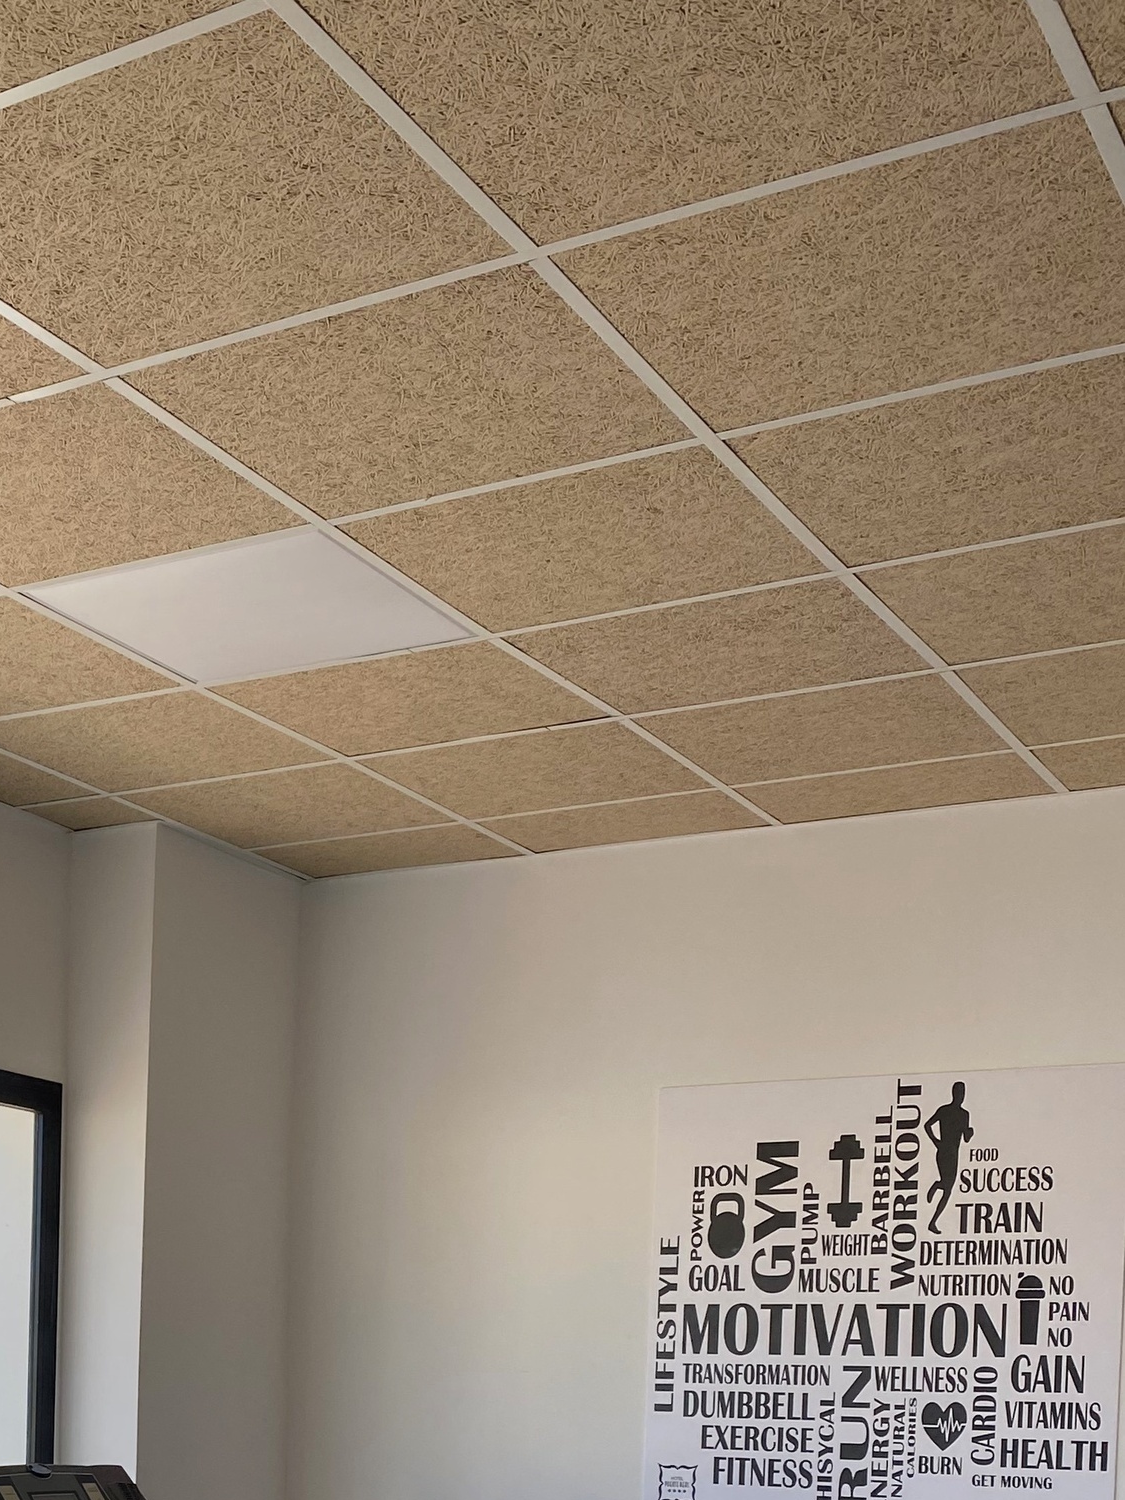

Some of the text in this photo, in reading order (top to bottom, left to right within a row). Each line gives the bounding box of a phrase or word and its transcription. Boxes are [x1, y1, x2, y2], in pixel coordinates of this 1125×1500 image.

[969, 1148, 999, 1162] FOOD
[693, 1164, 748, 1187] IRON
[870, 1105, 893, 1255] BARBELL
[890, 1079, 922, 1290] WORKOUT
[959, 1166, 1053, 1193] SUCCESS
[690, 1189, 705, 1261] POWER
[751, 1140, 800, 1293] GYM
[800, 1182, 819, 1264] PUMP
[955, 1202, 1043, 1234] TRAIN
[821, 1233, 870, 1256] WEIGHT
[919, 1238, 1068, 1266] DETERMINATION
[688, 1264, 745, 1292] GOAL
[798, 1268, 880, 1293] MUSCLE
[918, 1274, 1011, 1296] NUTRITION
[1049, 1275, 1074, 1296] NO
[654, 1235, 680, 1412] LIFESTYLE
[1048, 1301, 1090, 1321] PAIN
[681, 1302, 1007, 1359] MOTIVATION
[1047, 1327, 1073, 1347] NO
[682, 1363, 831, 1386] TRANSFORMATION
[875, 1366, 968, 1394] WELLNESS
[1010, 1354, 1086, 1394] GAIN
[683, 1390, 816, 1421] DUMBBELL
[970, 1366, 999, 1466] CARDIO
[1005, 1401, 1102, 1431] VITAMINS
[701, 1424, 814, 1453] EXERCISE
[891, 1398, 906, 1498] NATURAL
[906, 1396, 918, 1479] CALORIES
[918, 1456, 963, 1476] BURN
[1000, 1438, 1109, 1472] HEALTH
[712, 1456, 814, 1489] FITNESS
[971, 1474, 1053, 1490] GET MOVING
